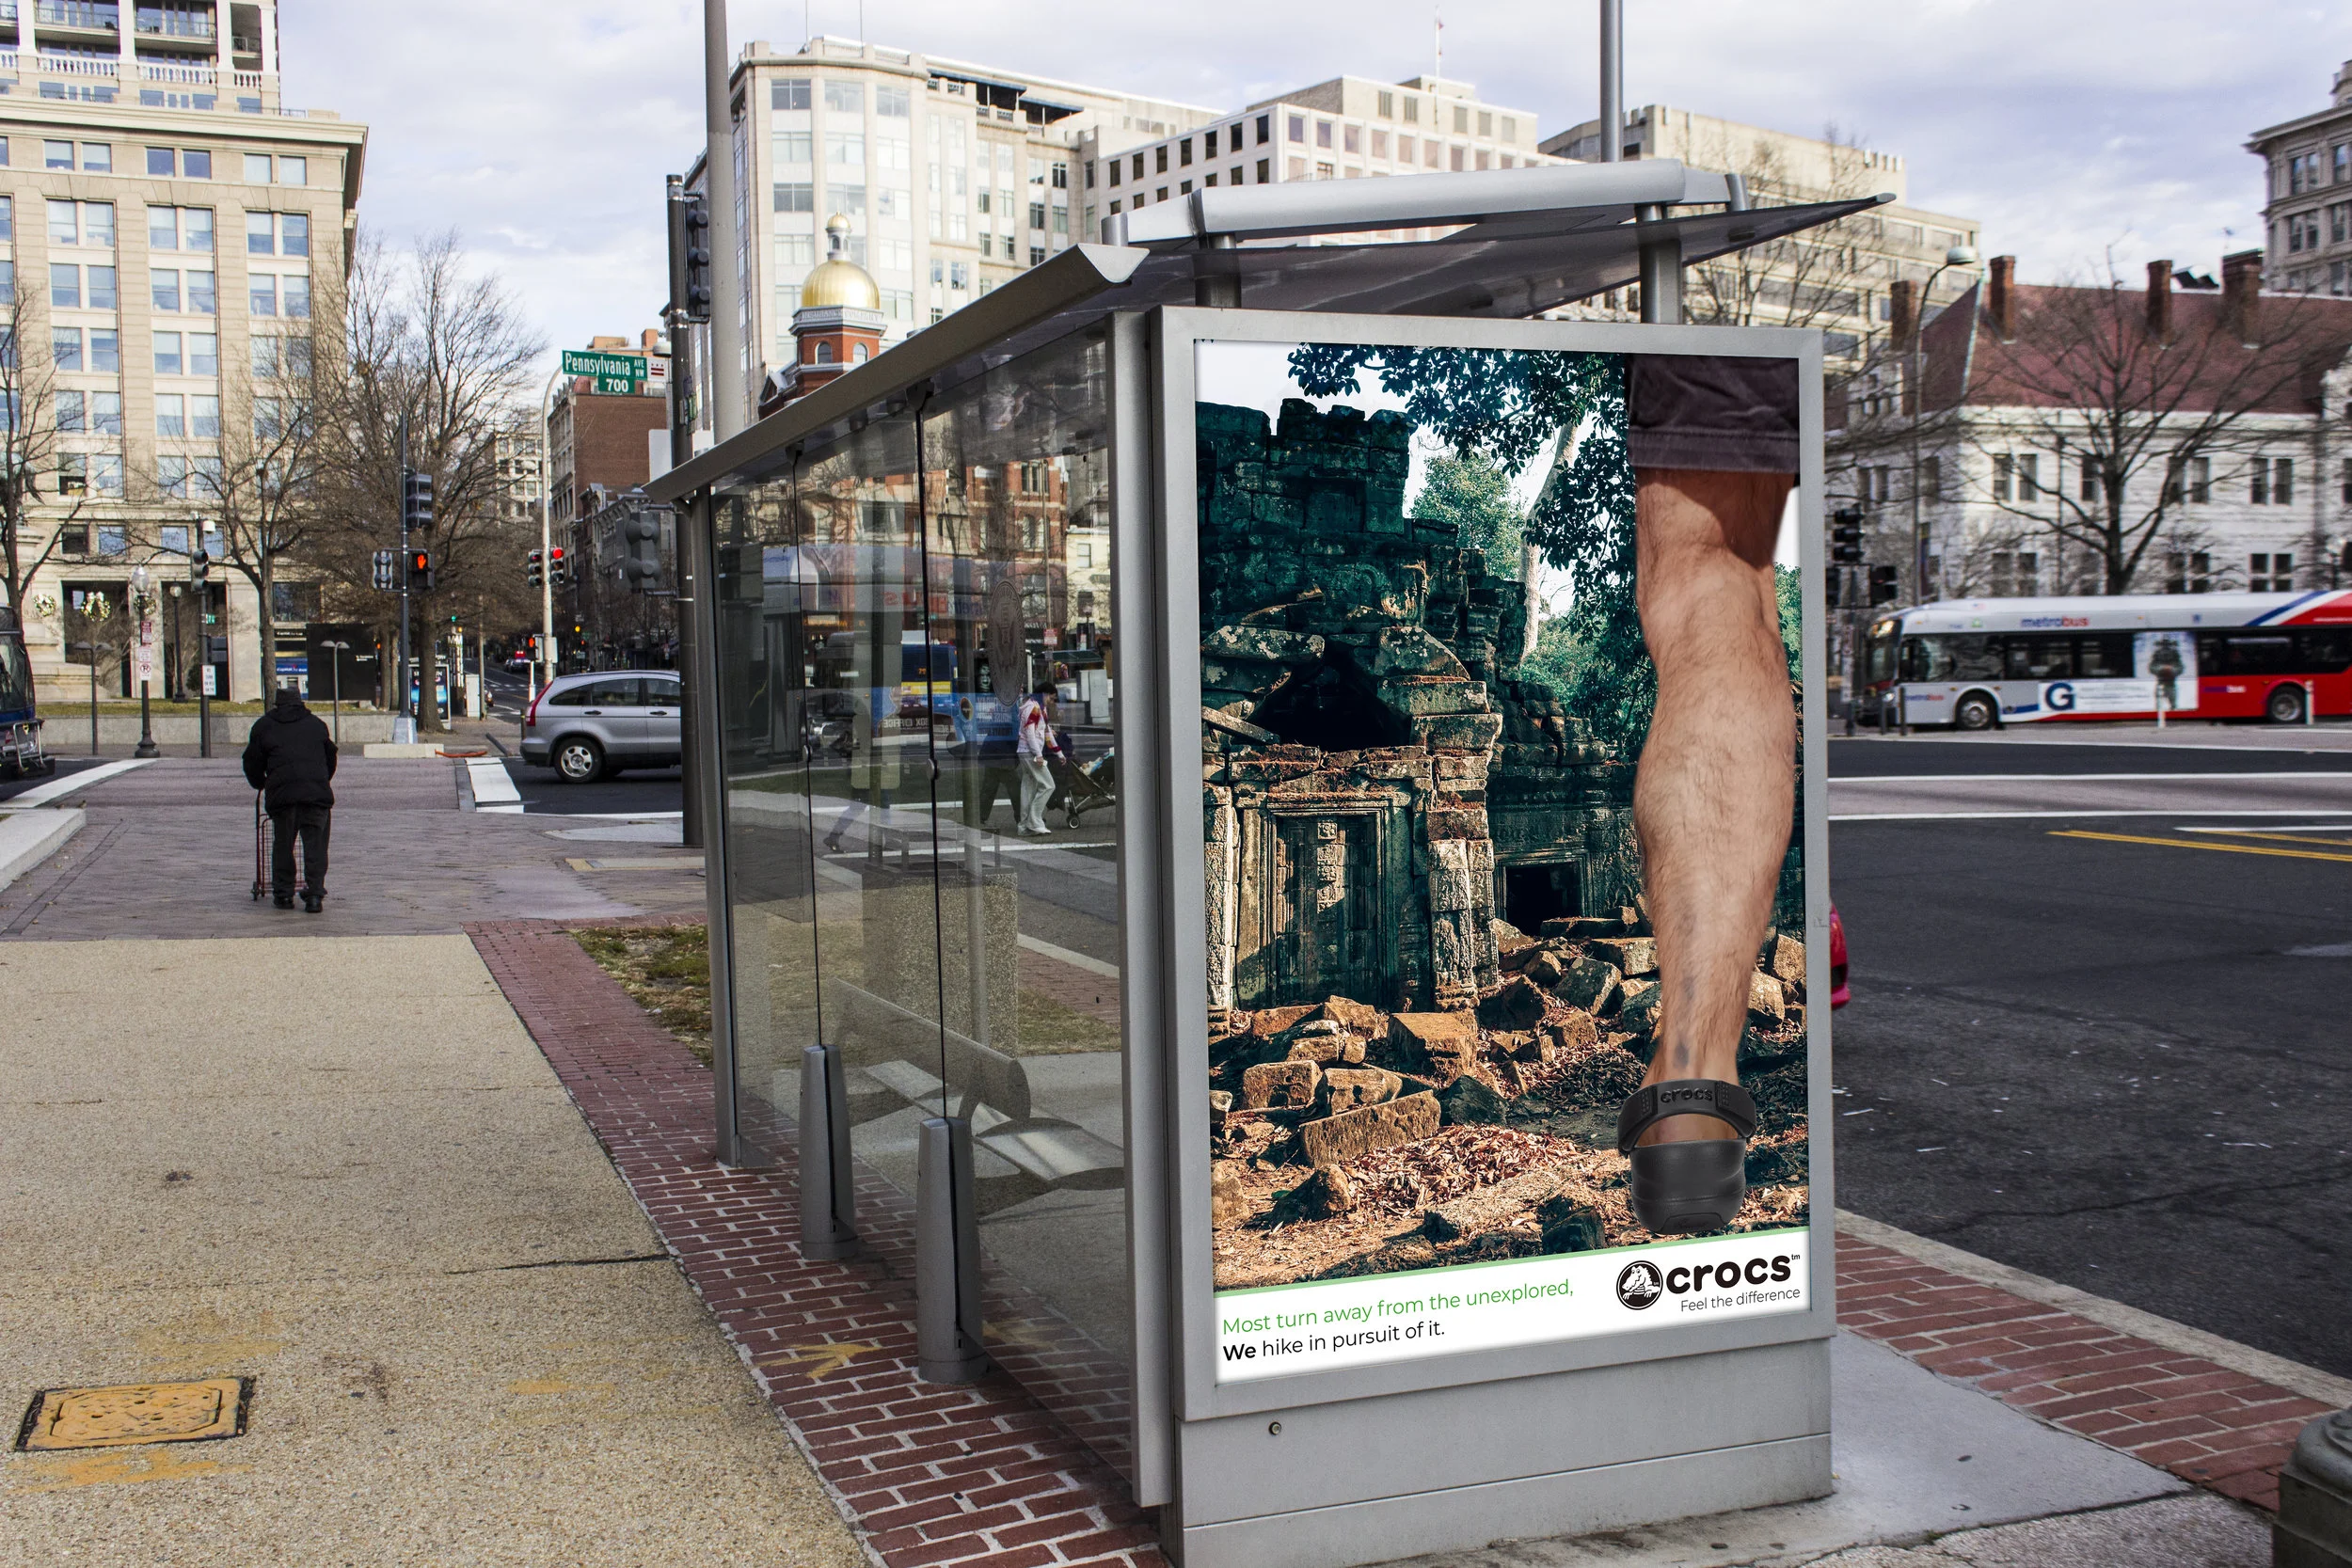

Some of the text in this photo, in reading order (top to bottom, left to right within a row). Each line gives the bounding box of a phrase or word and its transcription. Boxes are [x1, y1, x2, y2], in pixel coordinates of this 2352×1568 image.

[565, 352, 644, 376] Pennsylvania AVE
[606, 378, 629, 392] 700
[2022, 616, 2089, 627] metrobus
[2045, 682, 2075, 711] G
[1660, 1087, 1713, 1103] crocs
[1666, 1255, 1791, 1294] crocs
[1223, 1279, 1574, 1335] Most turn away from the unexplored,
[1681, 1289, 1801, 1312] Feel the difference
[1223, 1321, 1445, 1361] We hike in pursuit of it.
